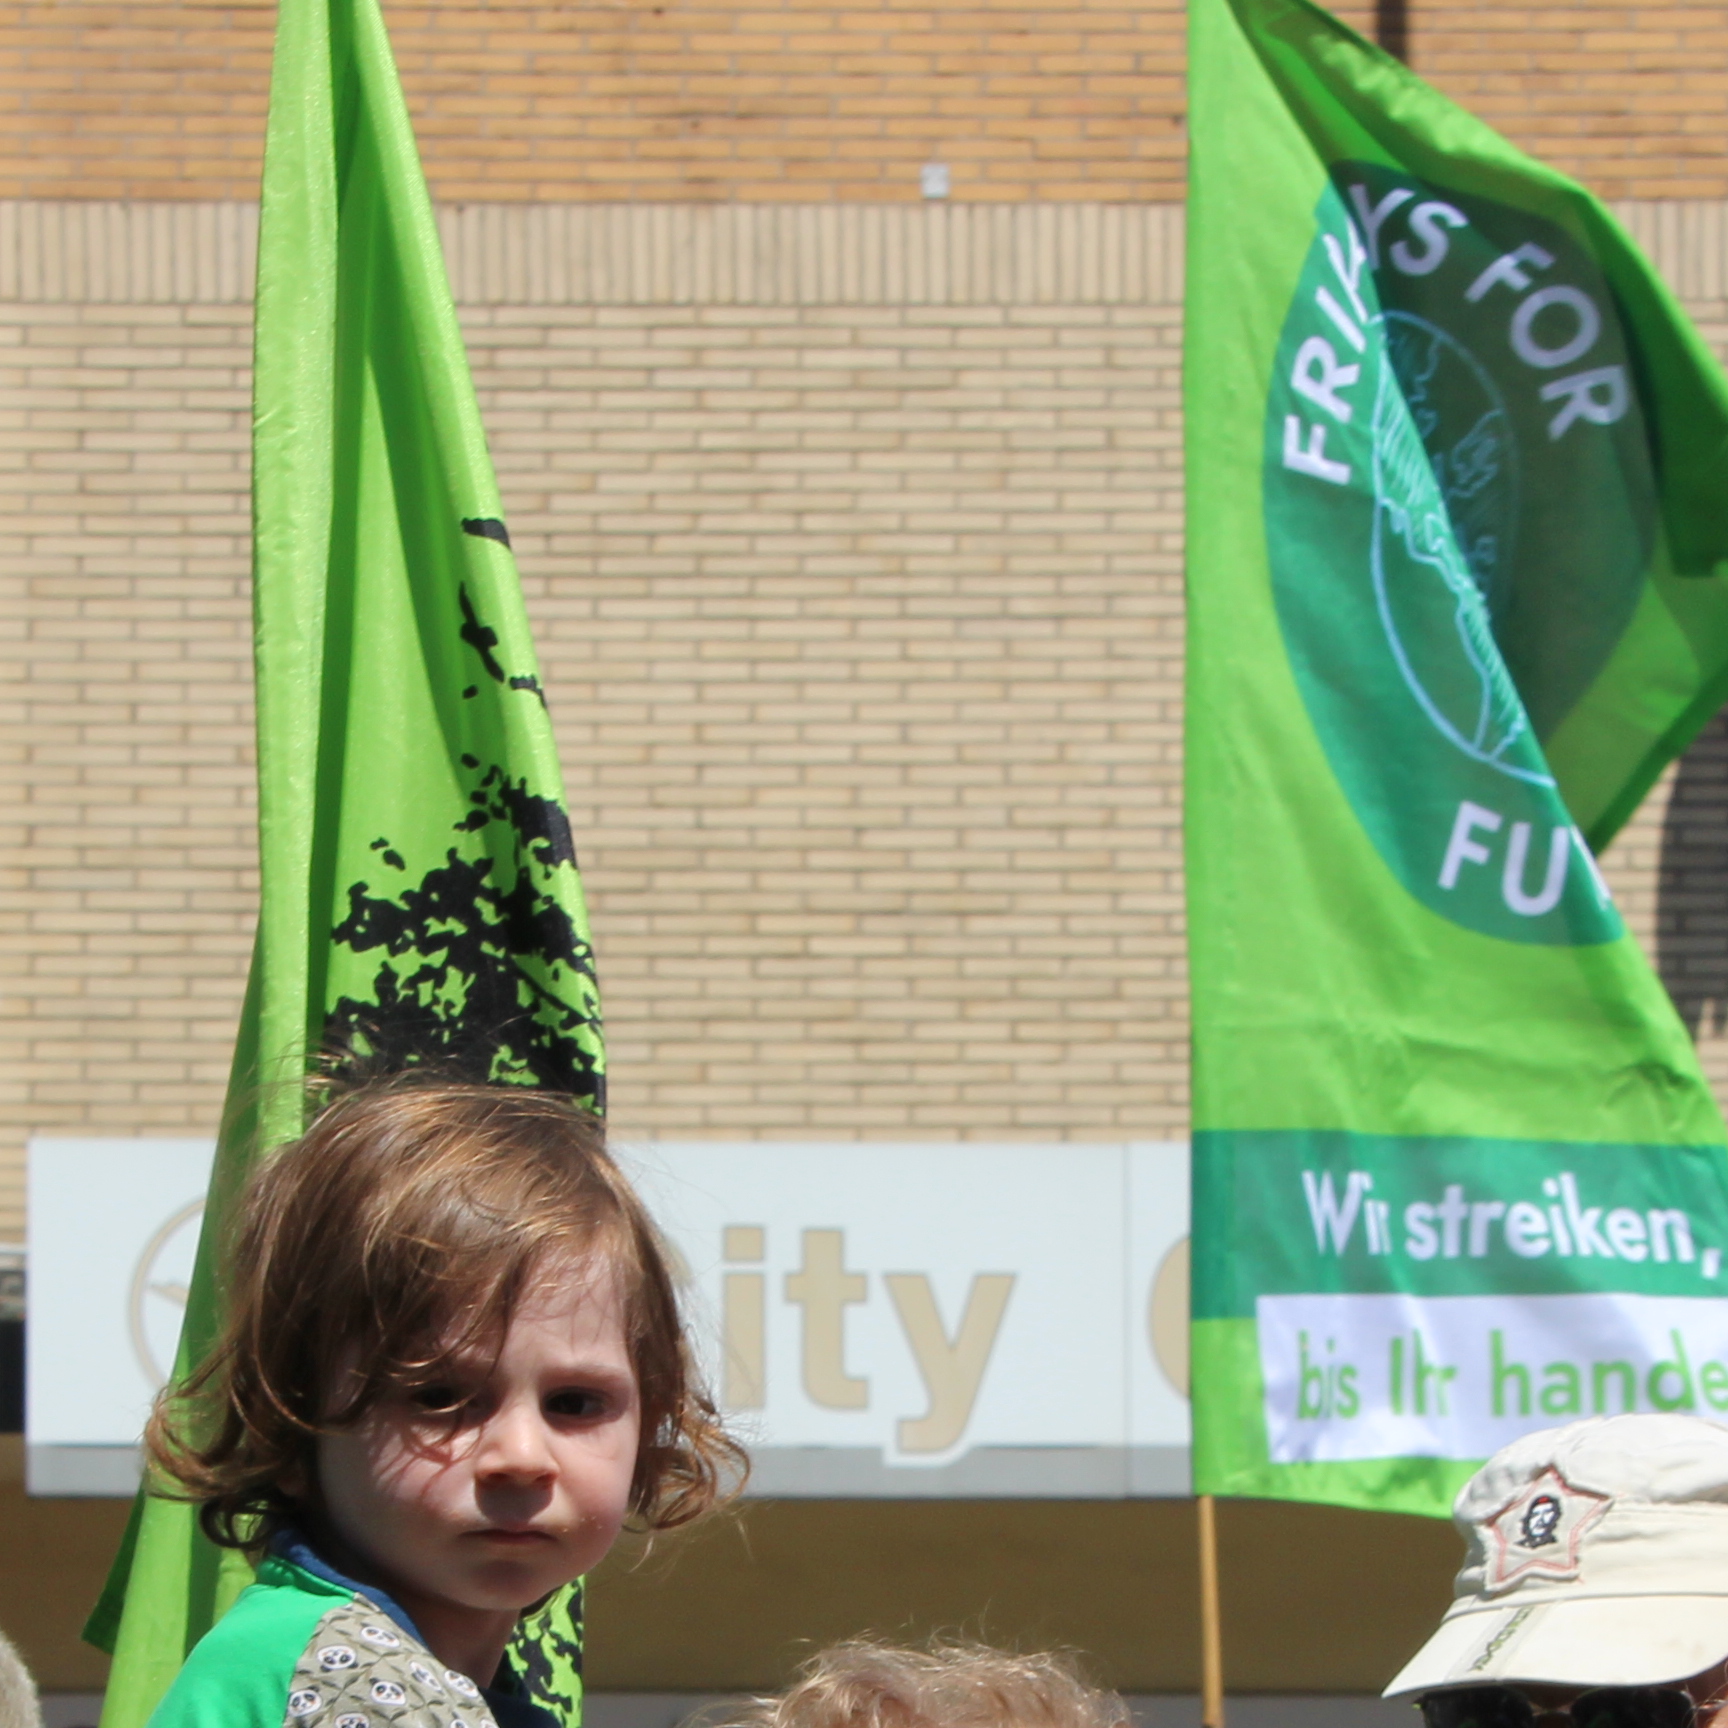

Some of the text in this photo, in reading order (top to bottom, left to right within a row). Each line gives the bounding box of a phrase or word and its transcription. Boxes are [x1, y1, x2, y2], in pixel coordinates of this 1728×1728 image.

[1465, 242, 1630, 441] FOR
[1404, 1172, 1722, 1280] streiken,
[723, 1225, 1016, 1452] ity
[1296, 1330, 1359, 1420] bis
